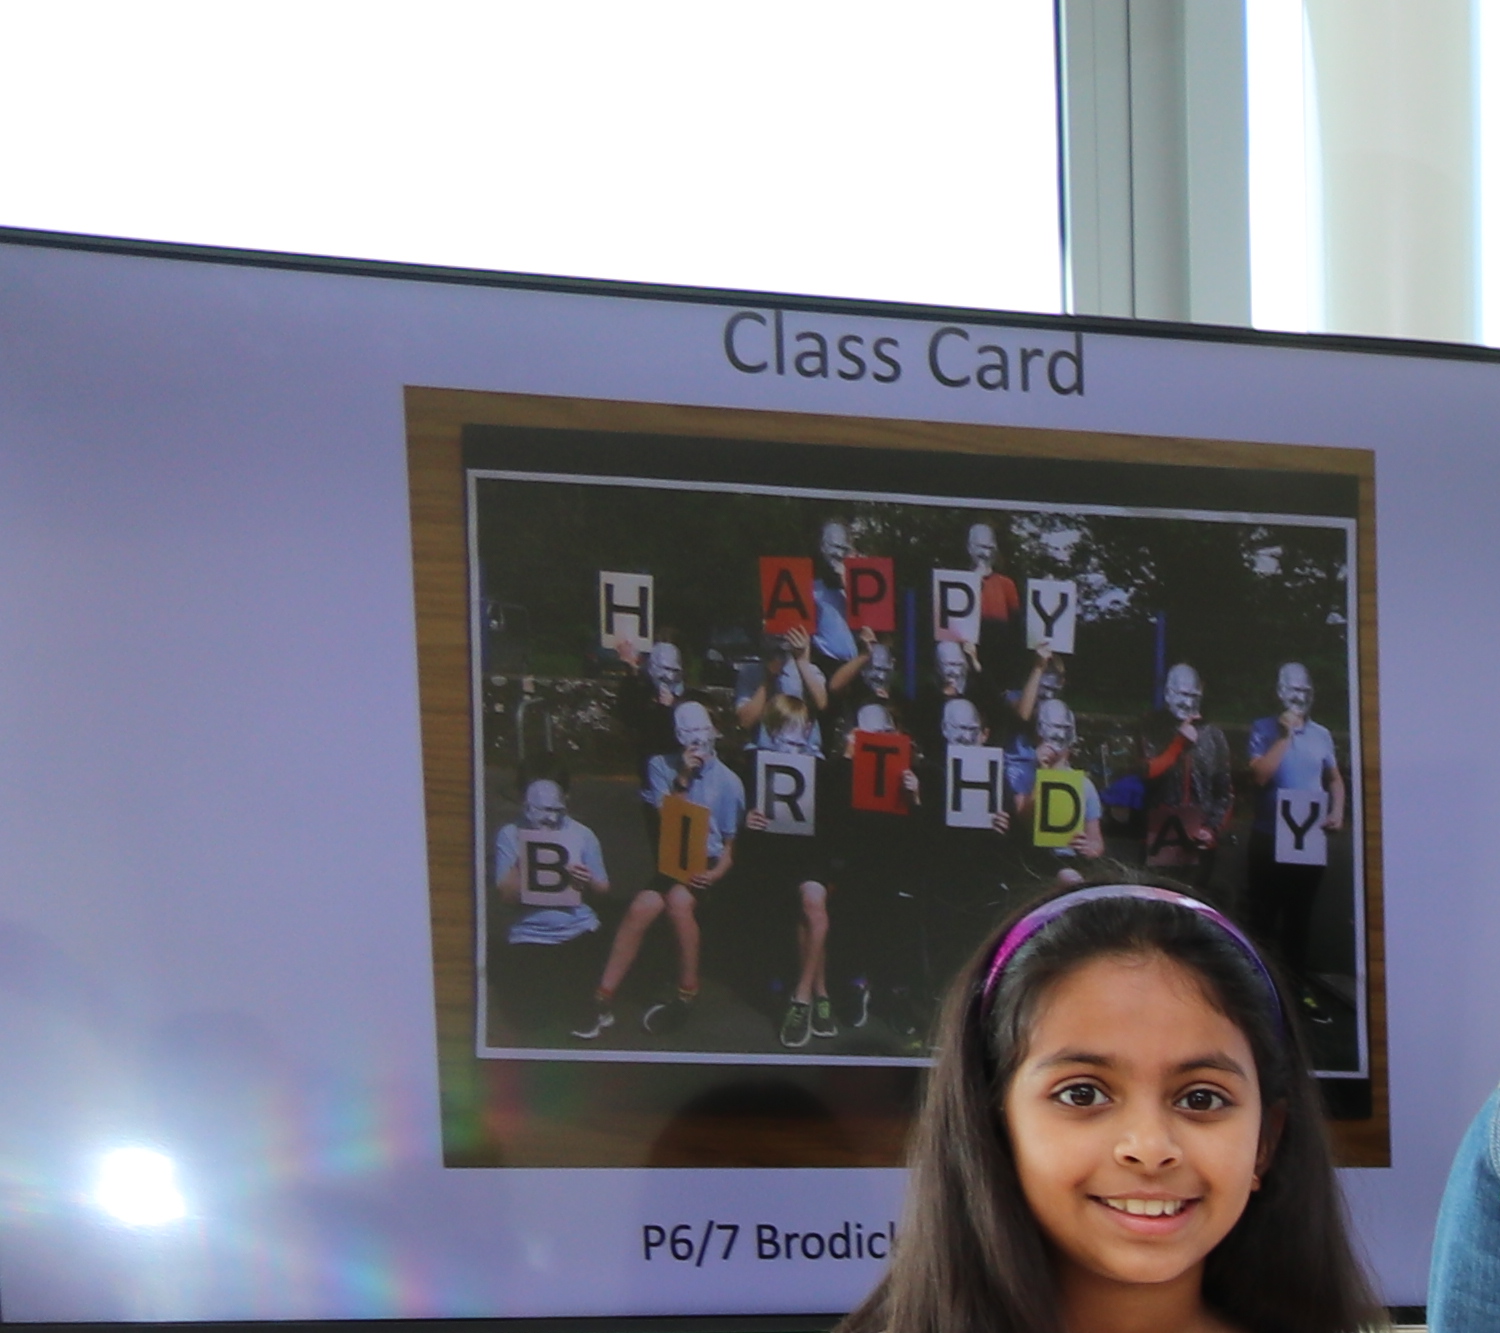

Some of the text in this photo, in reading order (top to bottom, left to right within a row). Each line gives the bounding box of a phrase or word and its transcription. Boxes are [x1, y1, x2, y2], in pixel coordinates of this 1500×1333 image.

[724, 309, 1084, 397] Class Card
[643, 1220, 740, 1267] P6/7
